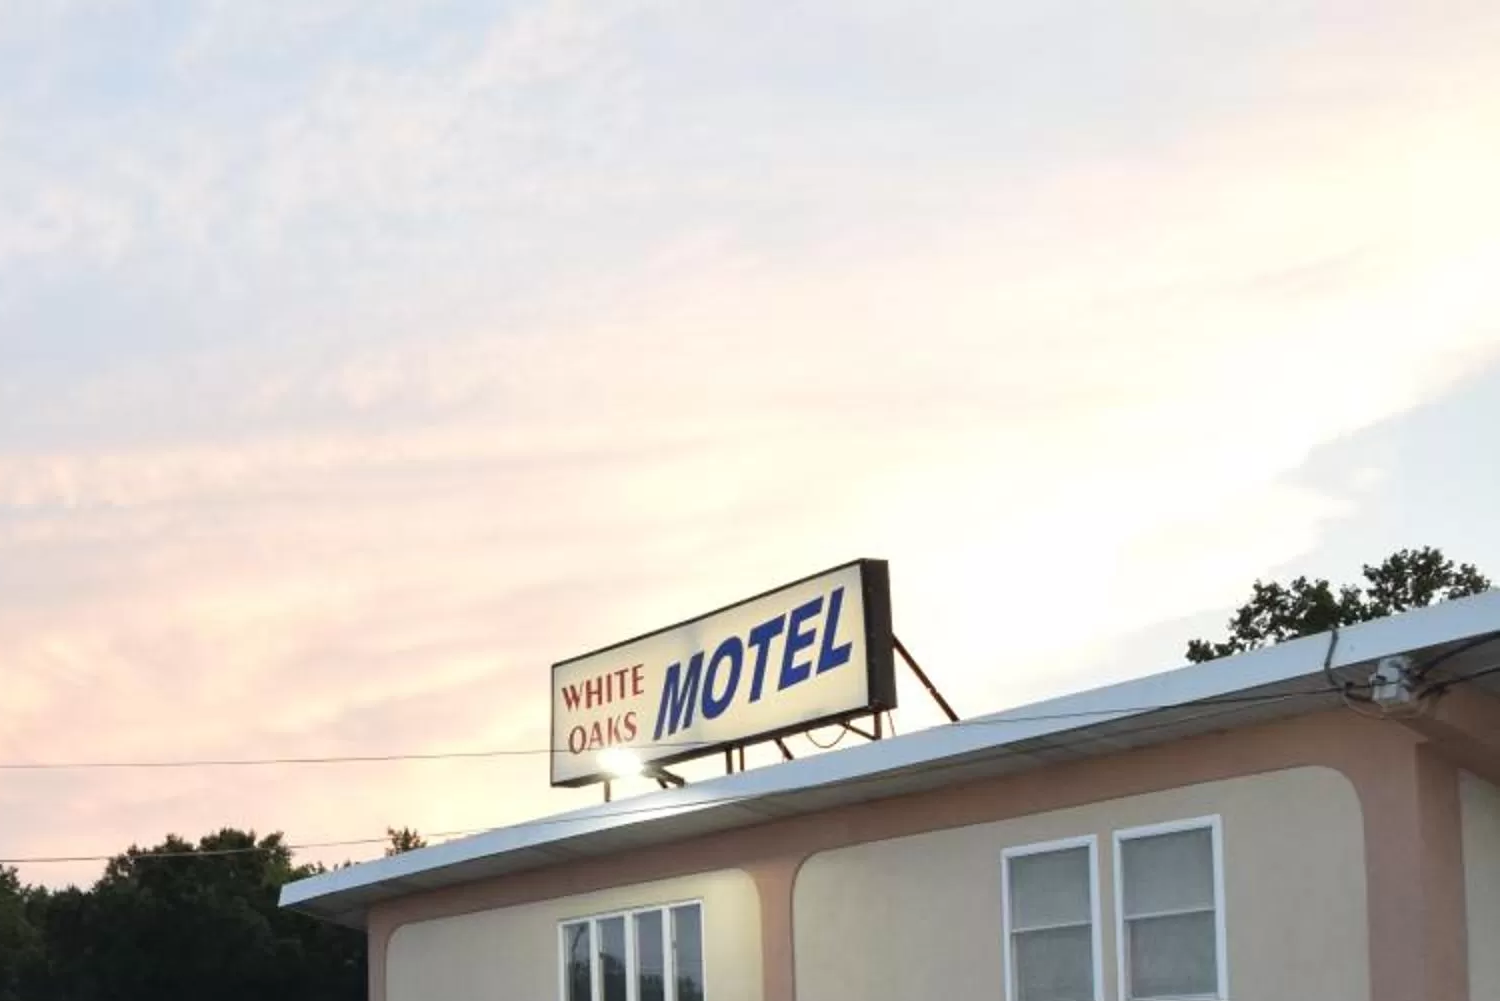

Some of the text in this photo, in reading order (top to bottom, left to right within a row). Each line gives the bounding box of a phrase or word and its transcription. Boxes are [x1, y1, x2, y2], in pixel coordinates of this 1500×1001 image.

[561, 663, 645, 712] WHITE
[652, 585, 853, 741] MOTEL
[568, 711, 637, 755] OAKS
